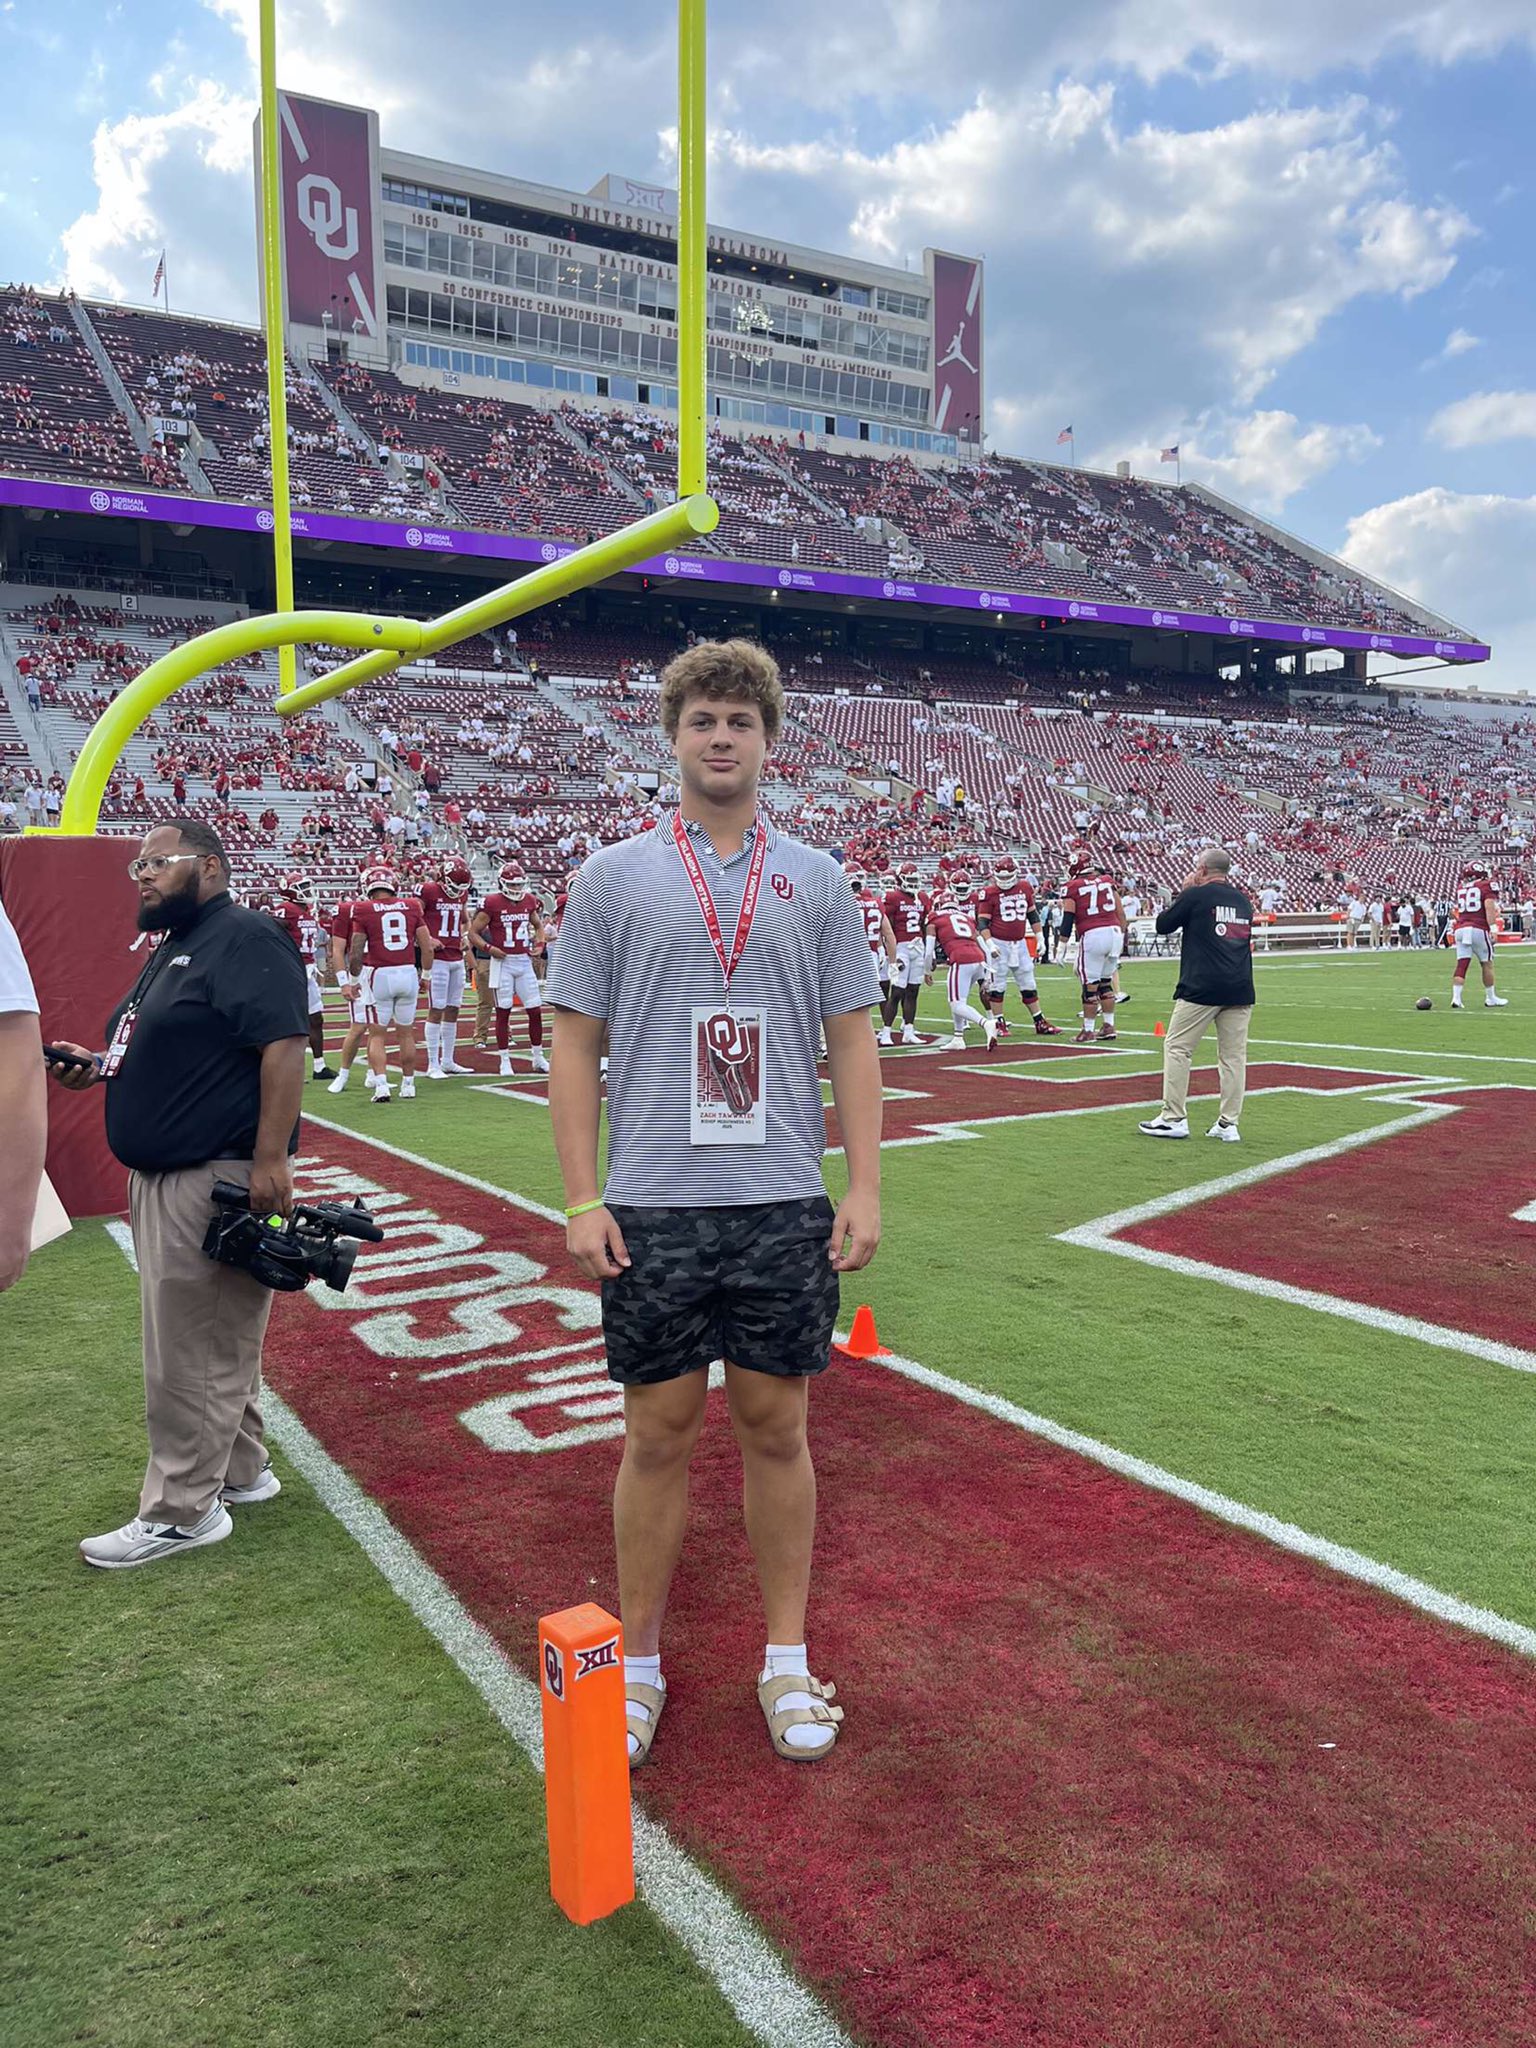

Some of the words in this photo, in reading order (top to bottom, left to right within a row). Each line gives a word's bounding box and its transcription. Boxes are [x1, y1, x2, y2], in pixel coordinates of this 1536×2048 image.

[297, 173, 359, 260] OU
[570, 203, 673, 239] UNIVERSITY
[708, 235, 788, 266] OKLAHOMA
[412, 213, 438, 229] 1950
[458, 223, 484, 239] 1955
[504, 233, 529, 248] 1956
[547, 241, 572, 258] 1974
[599, 253, 673, 280] NATIONAL
[710, 277, 762, 300] MPIONS
[443, 282, 456, 294] 50
[461, 286, 533, 310] CONFERENCE
[537, 301, 623, 328] CHAMPIONSHIPS
[650, 323, 661, 335] 31
[802, 353, 816, 365] 167
[820, 357, 892, 380] ALL-AMERICANS
[445, 374, 459, 383] 104
[161, 420, 178, 433] 103
[400, 455, 416, 467] 104
[112, 496, 144, 506] NORMAN
[112, 503, 149, 514] REGIONAL
[125, 598, 133, 608] 2
[355, 763, 363, 777] 2
[632, 773, 639, 786] 3
[744, 875, 759, 915] OKLAHOMA
[752, 840, 765, 874] FOOTBALL
[771, 873, 794, 902] OU
[695, 880, 713, 918] FOOTBALL
[1000, 900, 1028, 922] 69
[1079, 882, 1116, 916] 73
[1457, 887, 1481, 913] 58
[437, 910, 461, 938] 11
[906, 911, 921, 933] 2
[950, 914, 972, 938] 6
[1216, 906, 1236, 924] MAN
[381, 911, 409, 951] 8
[503, 922, 530, 948] 14
[705, 1012, 751, 1064] OU
[544, 1642, 563, 1698] OU
[575, 1637, 619, 1679] XII
